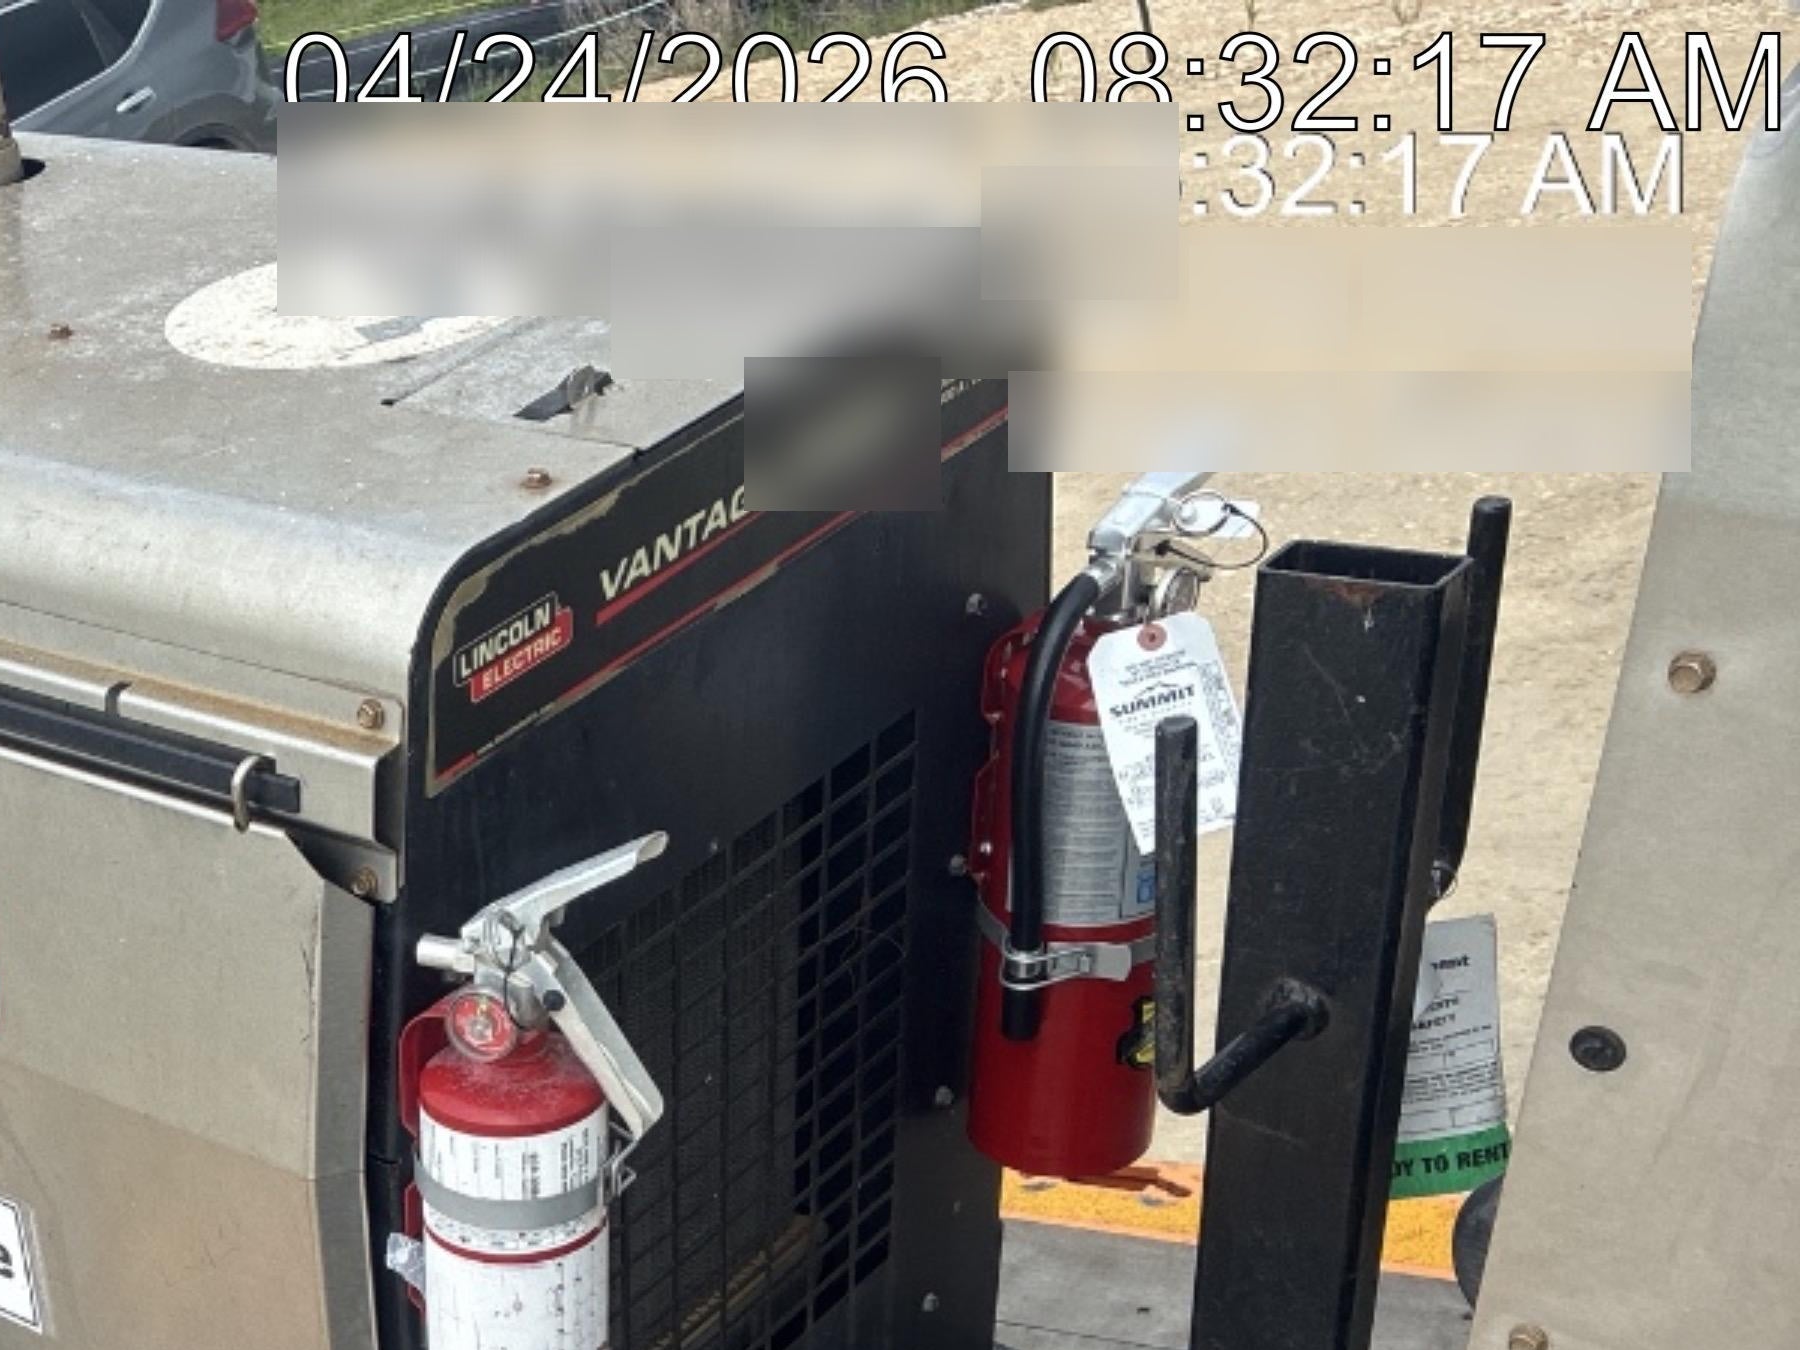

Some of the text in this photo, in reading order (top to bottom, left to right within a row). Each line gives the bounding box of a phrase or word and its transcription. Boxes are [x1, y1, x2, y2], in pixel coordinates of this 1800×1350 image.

[600, 485, 750, 600] VANTAG
[461, 602, 550, 679] LINCOLN
[482, 626, 562, 690] ELECTRIC
[1109, 684, 1195, 717] SUMMIT
[1422, 1153, 1449, 1174] TO
[1456, 1142, 1509, 1171] RENT
